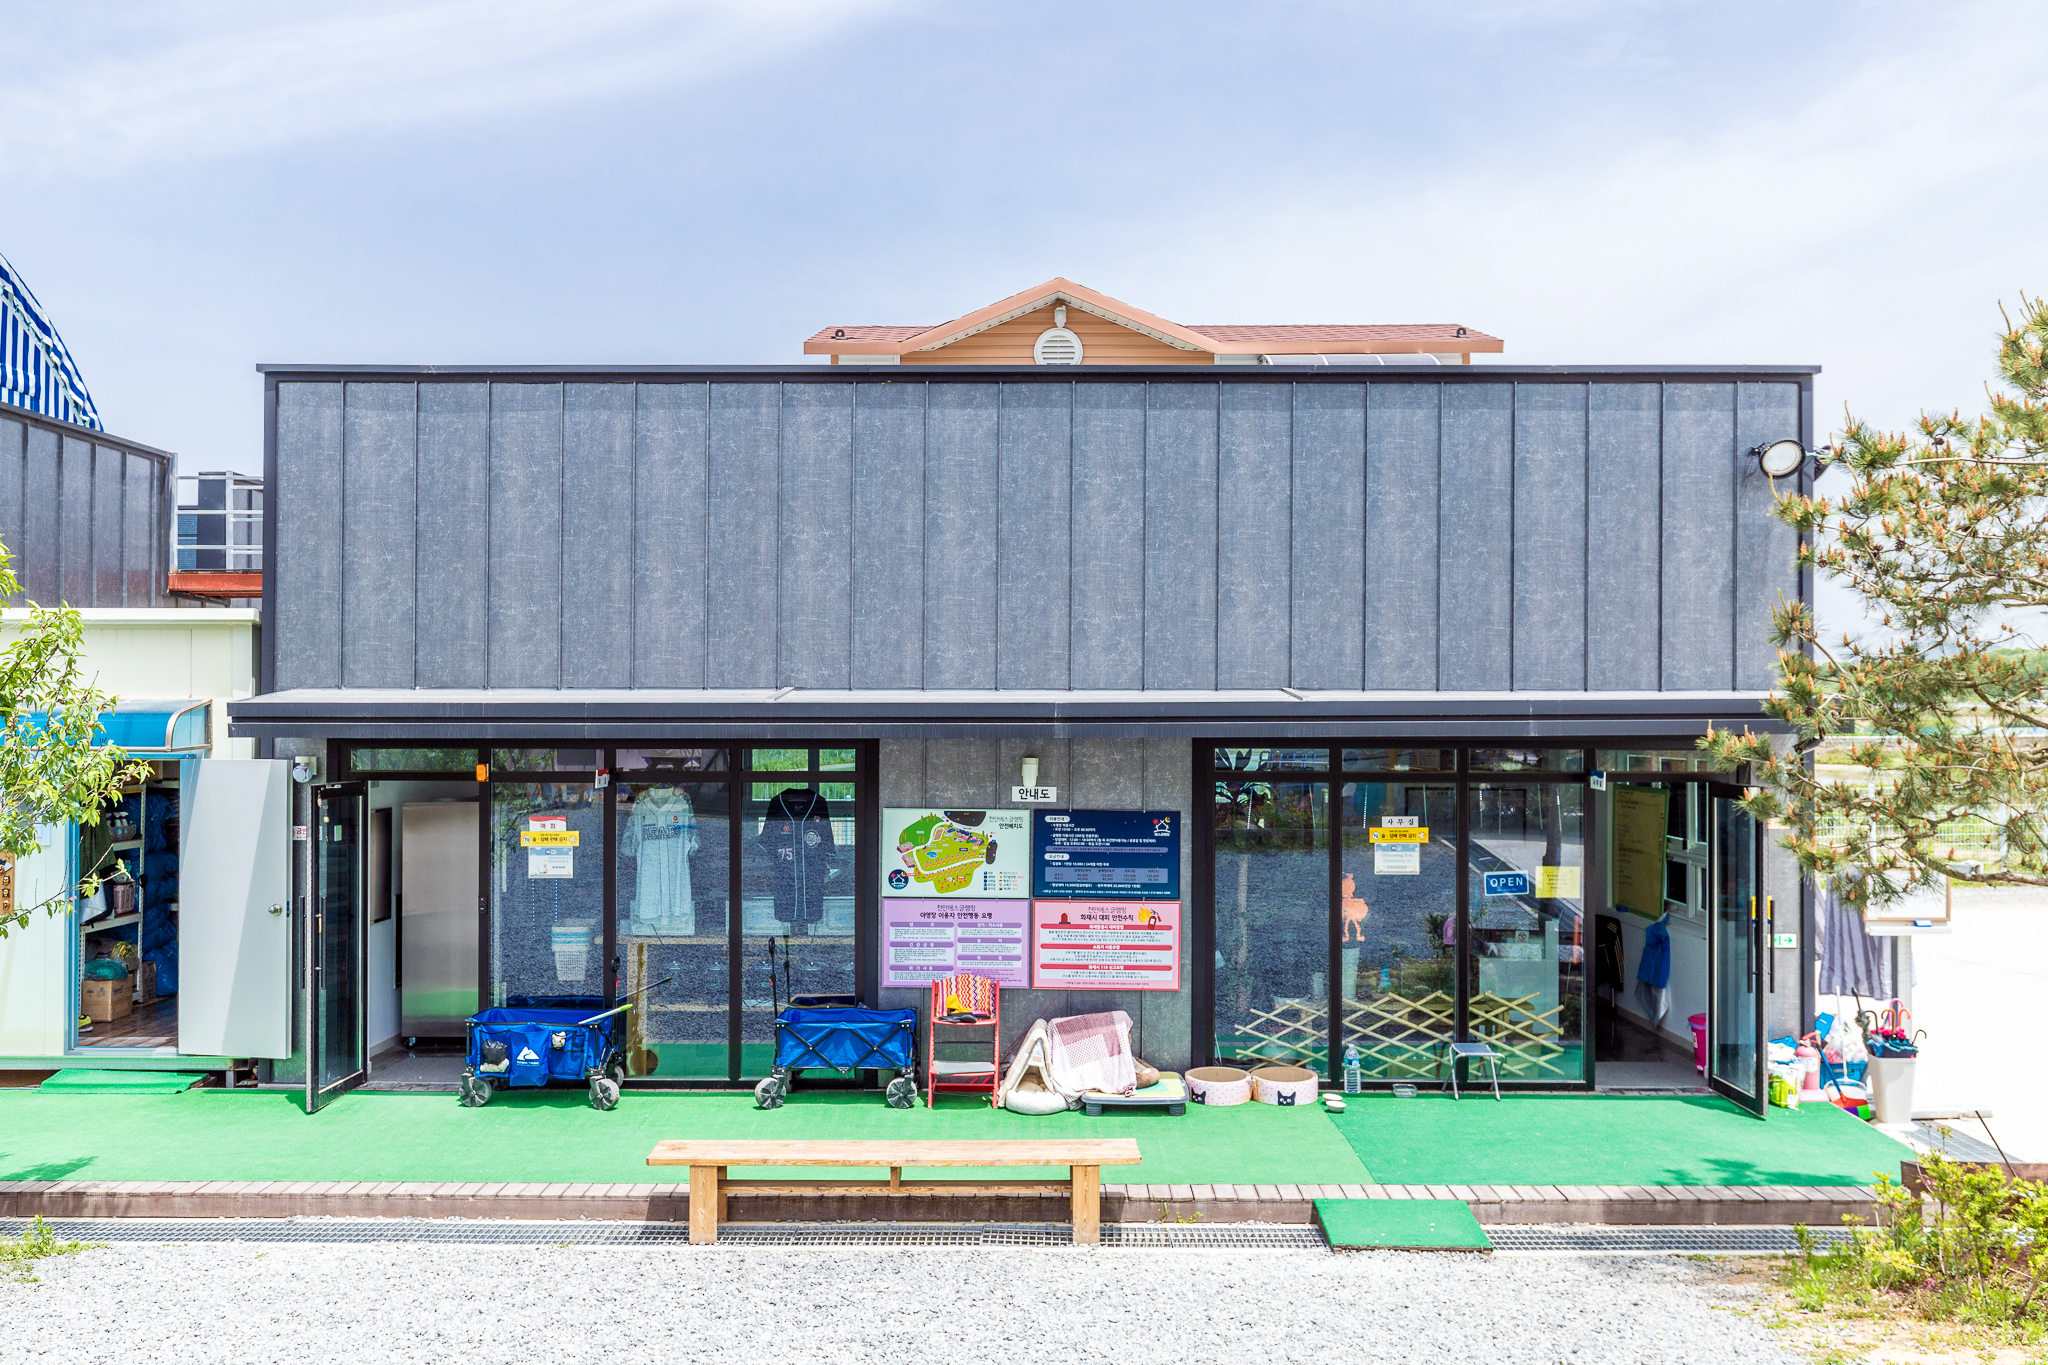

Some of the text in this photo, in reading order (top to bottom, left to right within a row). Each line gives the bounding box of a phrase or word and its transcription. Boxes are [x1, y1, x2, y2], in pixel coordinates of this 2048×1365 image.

[1018, 788, 1050, 800] 안내도
[1387, 818, 1414, 826] 사무실
[778, 848, 793, 860] 75
[1490, 877, 1523, 887] OPEN
[936, 904, 976, 912] 천안에스글램핑
[1088, 906, 1127, 914] 천안에스글램핑
